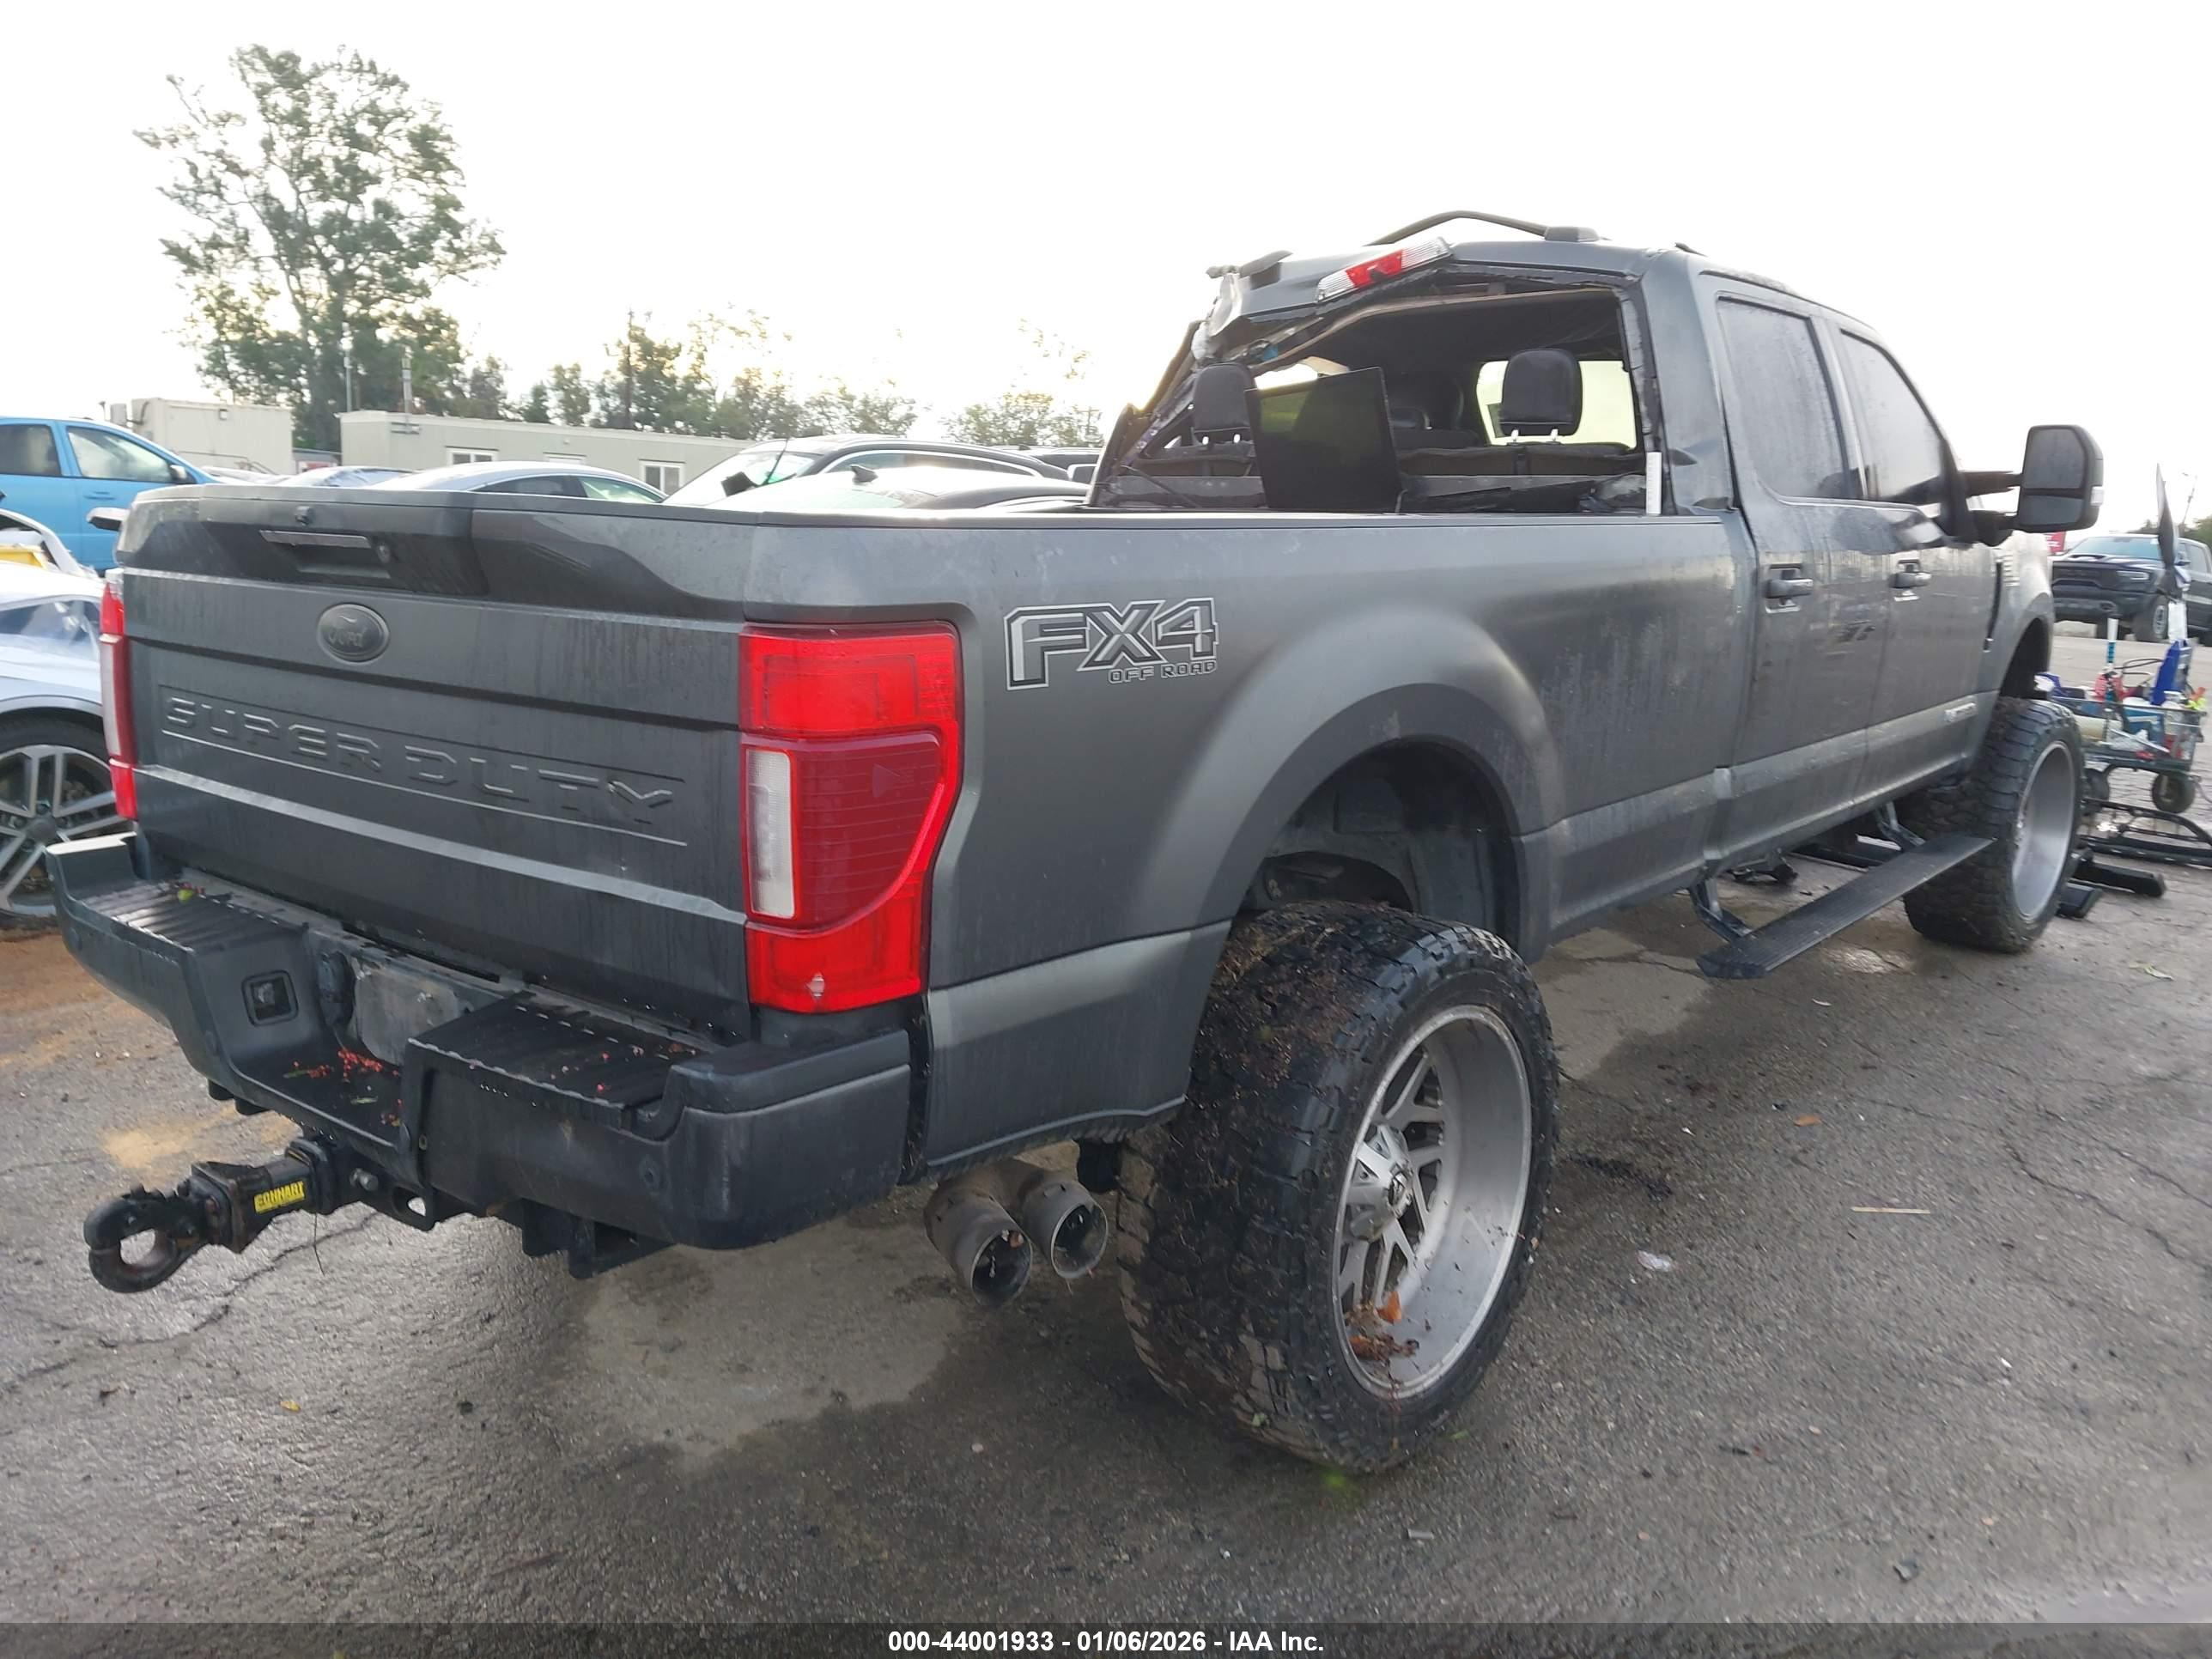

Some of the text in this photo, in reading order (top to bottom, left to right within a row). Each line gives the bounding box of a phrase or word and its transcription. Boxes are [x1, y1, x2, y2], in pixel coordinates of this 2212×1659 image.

[1004, 597, 1219, 690] FX4
[1108, 659, 1218, 684] OFF ROAD
[167, 696, 675, 825] SUPER DUTY
